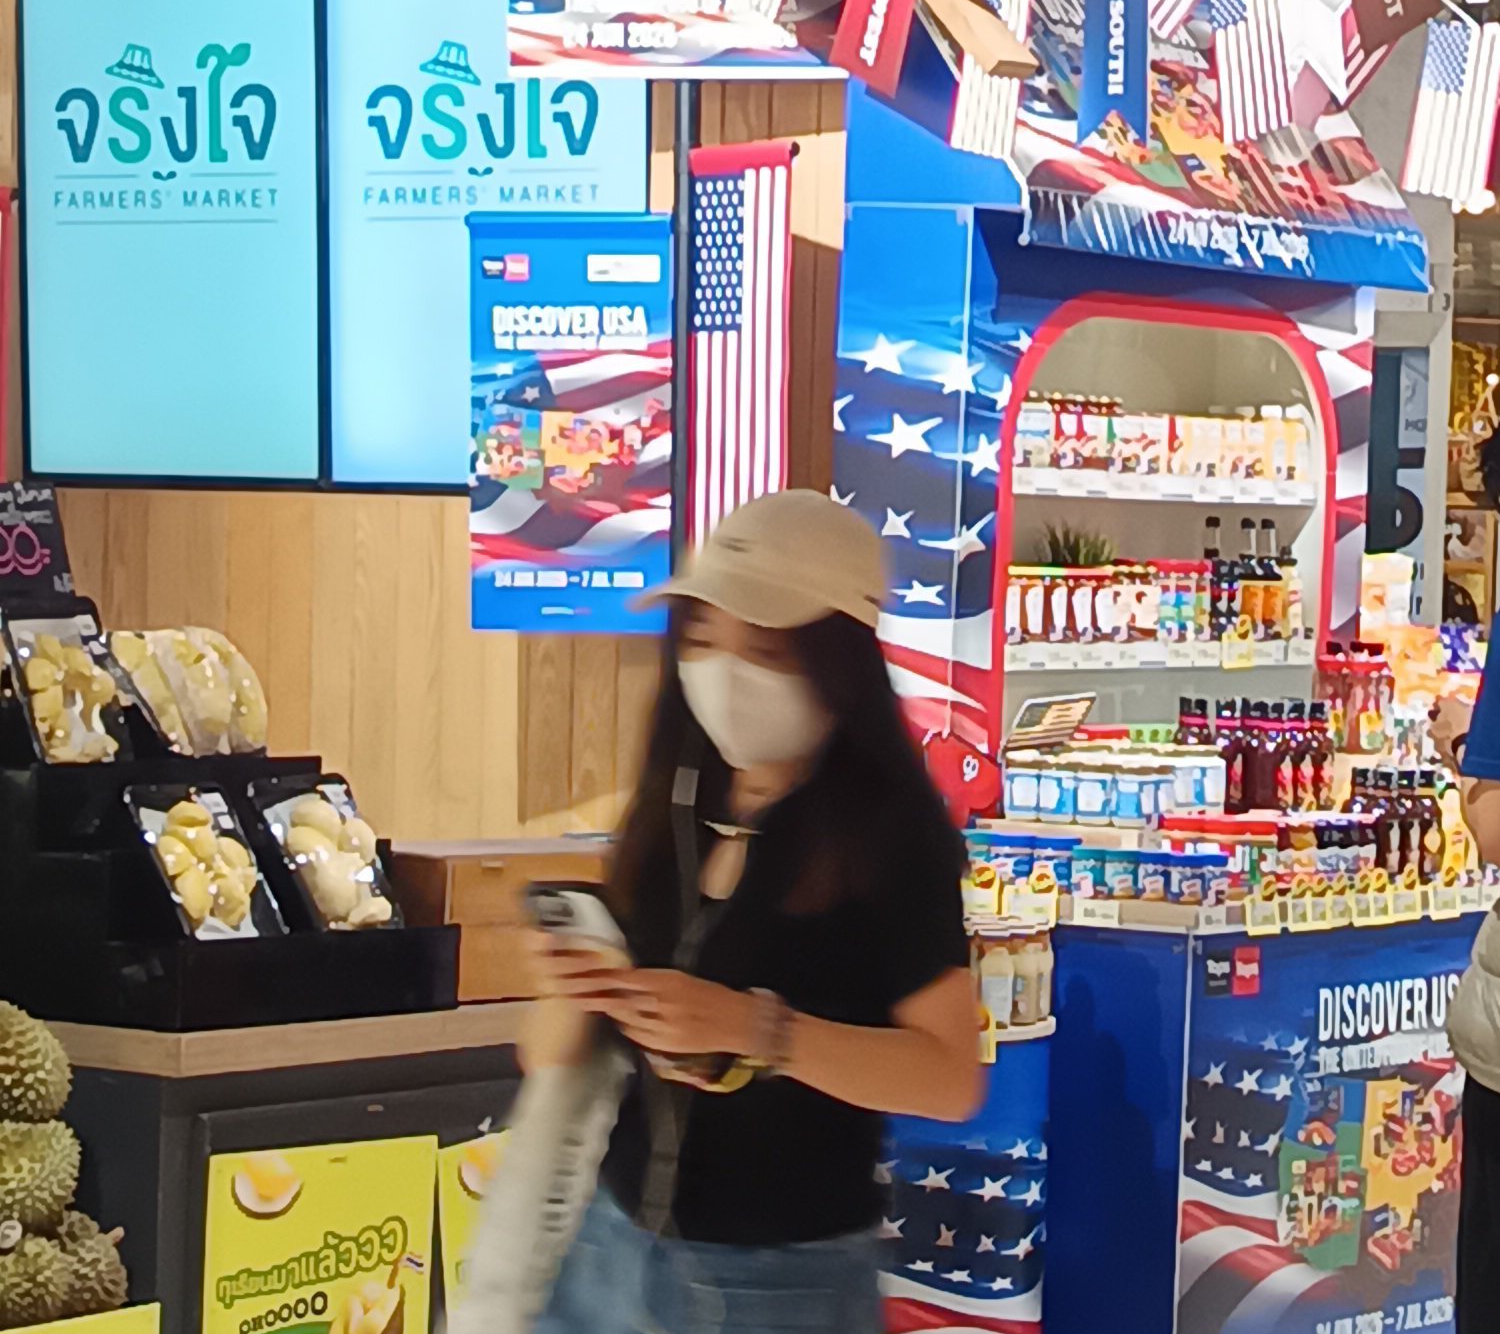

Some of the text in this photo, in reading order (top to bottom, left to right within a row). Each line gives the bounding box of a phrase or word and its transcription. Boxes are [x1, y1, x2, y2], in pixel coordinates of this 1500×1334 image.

[55, 43, 277, 164] จริงใจ
[182, 188, 279, 209] MARKET
[499, 183, 600, 204] MARKET
[1318, 972, 1461, 1042] DISCOVER US
